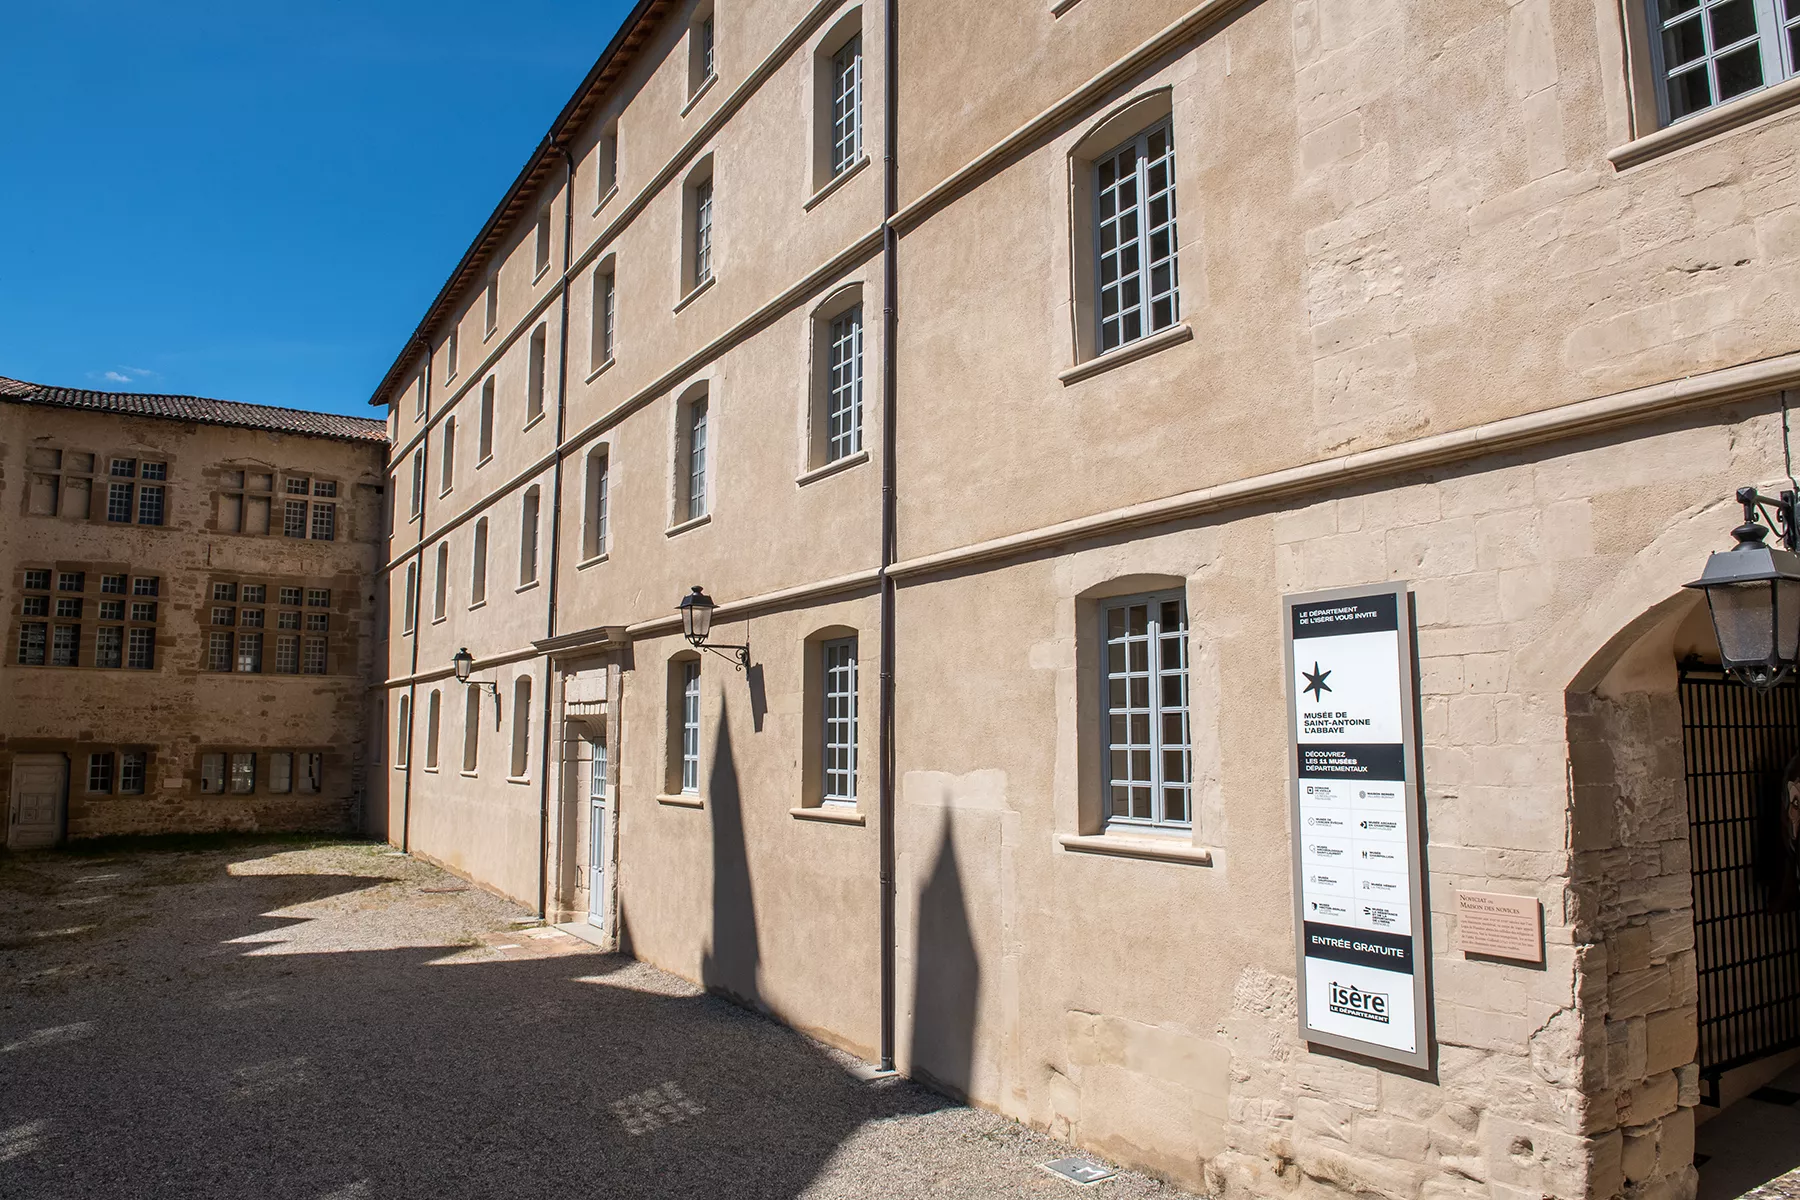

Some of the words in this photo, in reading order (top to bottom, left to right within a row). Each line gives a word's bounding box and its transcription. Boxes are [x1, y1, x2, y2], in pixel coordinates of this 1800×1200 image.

[1309, 606, 1358, 617] DÉPARTEMENT
[1355, 611, 1378, 619] INVITE
[1304, 711, 1333, 719] MUSÉE
[1304, 719, 1371, 727] SAINT-ANTOINE
[1304, 726, 1345, 734] L'ABBAYE
[1305, 765, 1368, 773] DÉPARTEMENTAUX
[1311, 935, 1351, 950] ENTRÉE
[1353, 942, 1404, 958] GRATUITE
[1332, 981, 1385, 1013] isère
[1339, 1007, 1388, 1022] DÉPARTEMENT
